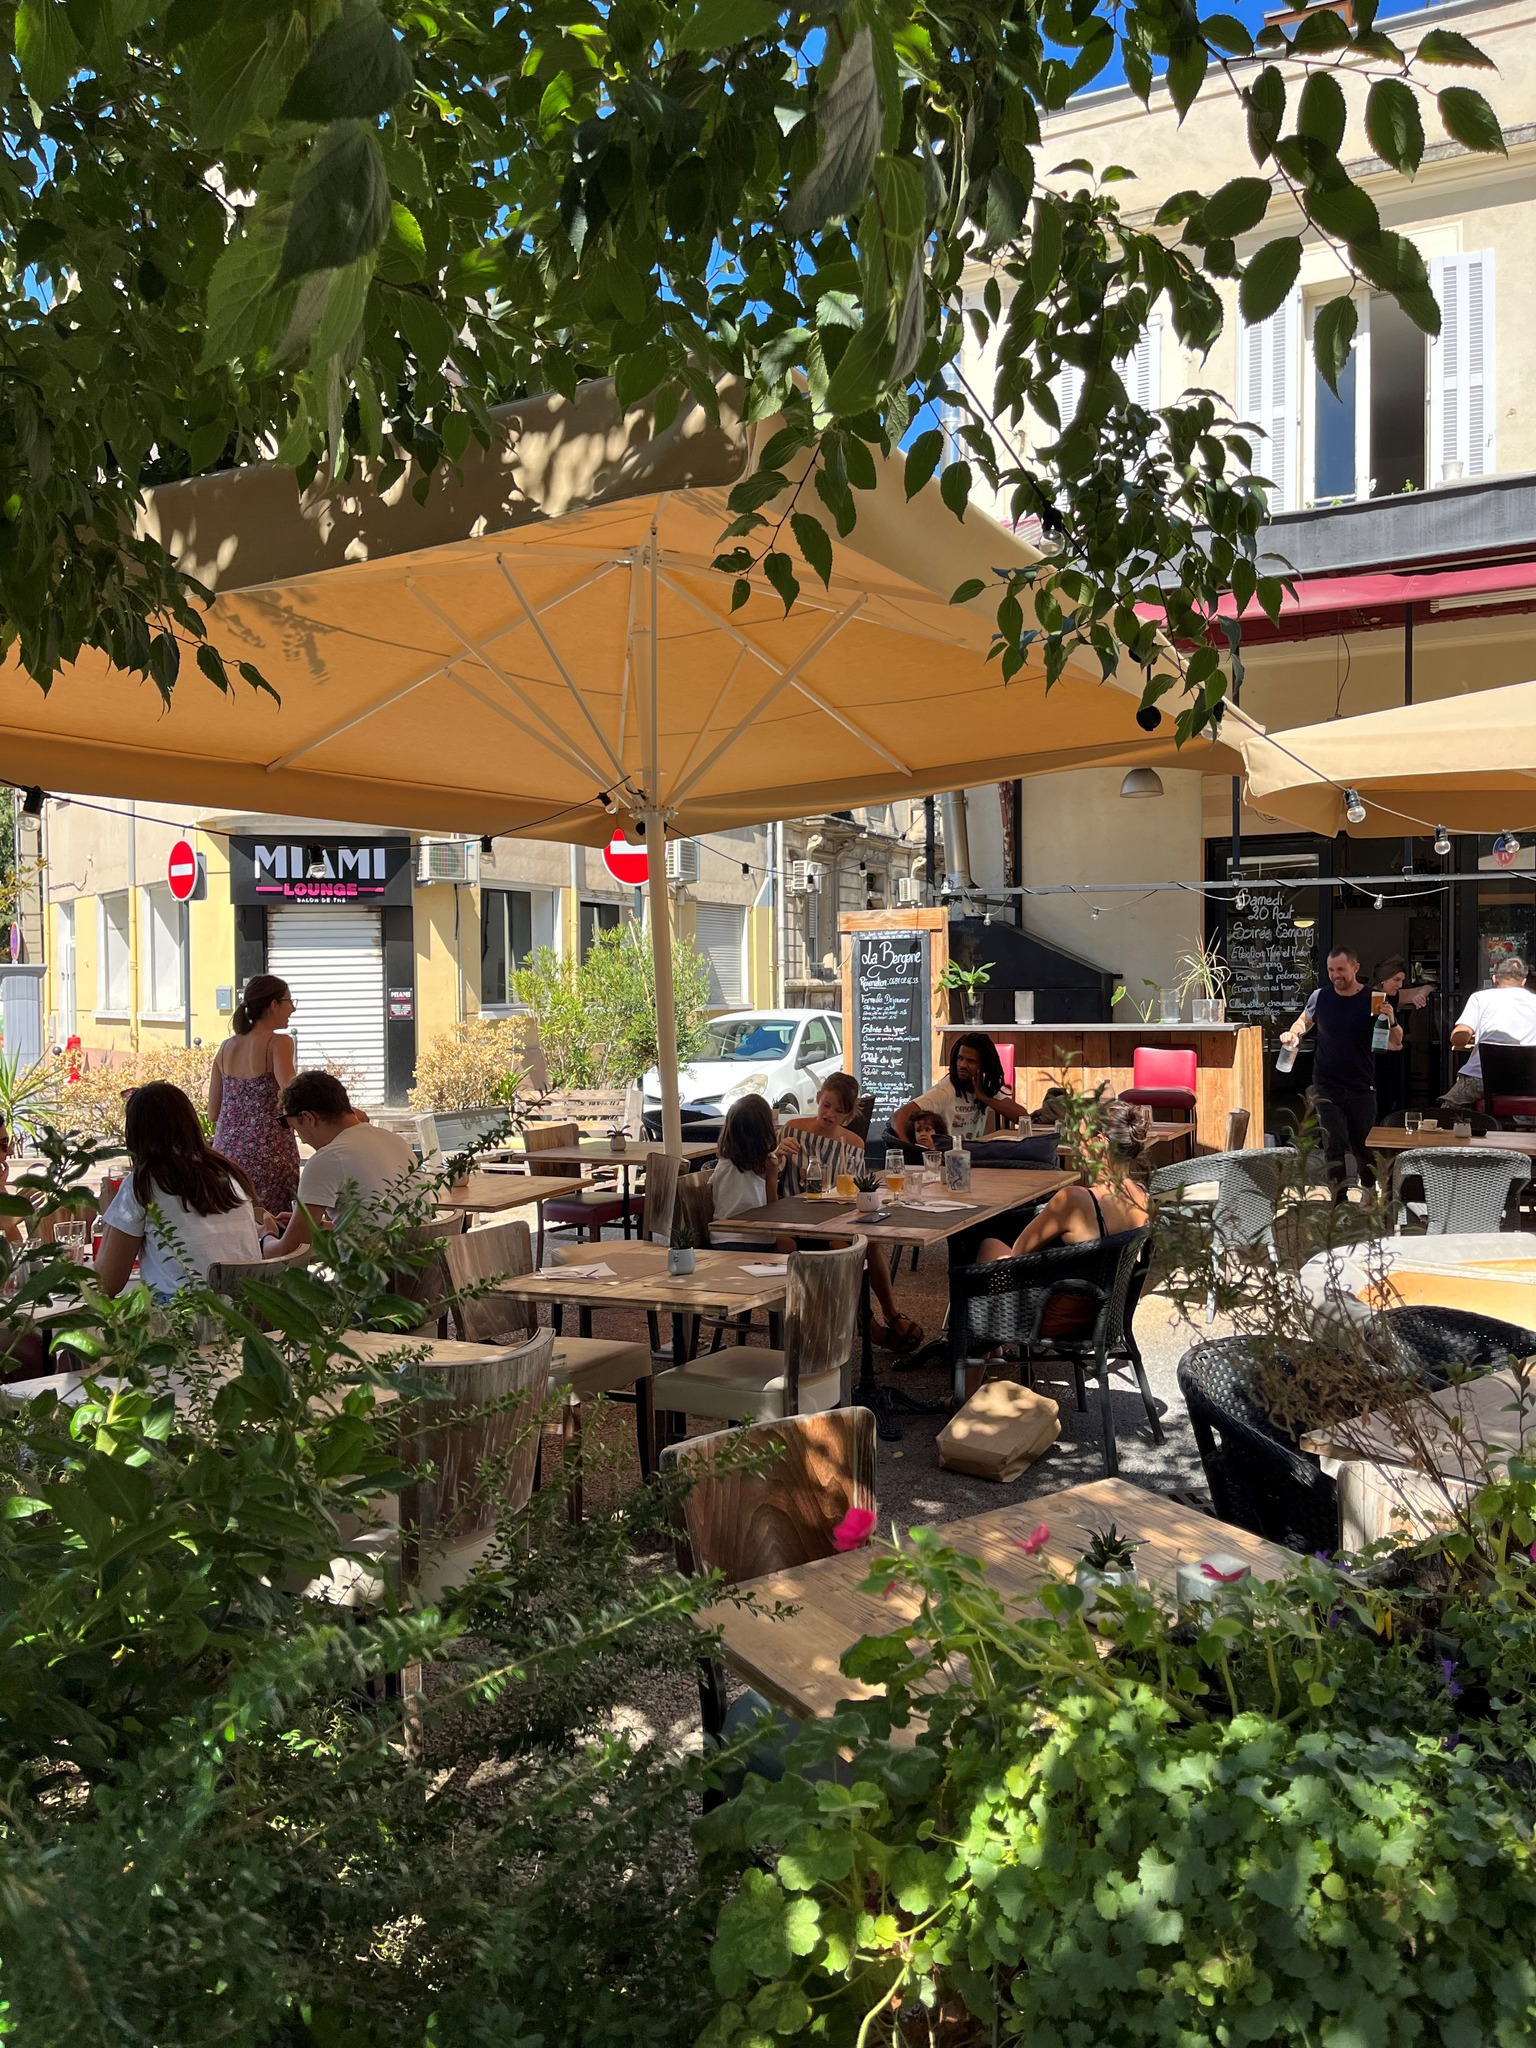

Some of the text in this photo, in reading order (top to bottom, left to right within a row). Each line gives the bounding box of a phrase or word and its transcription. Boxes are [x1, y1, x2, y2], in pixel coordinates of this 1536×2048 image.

[254, 845, 386, 879] MIAMI
[283, 882, 358, 896] LOUNGE
[1238, 887, 1285, 907] Samedi
[1247, 905, 1270, 920] 20
[861, 941, 878, 965] La
